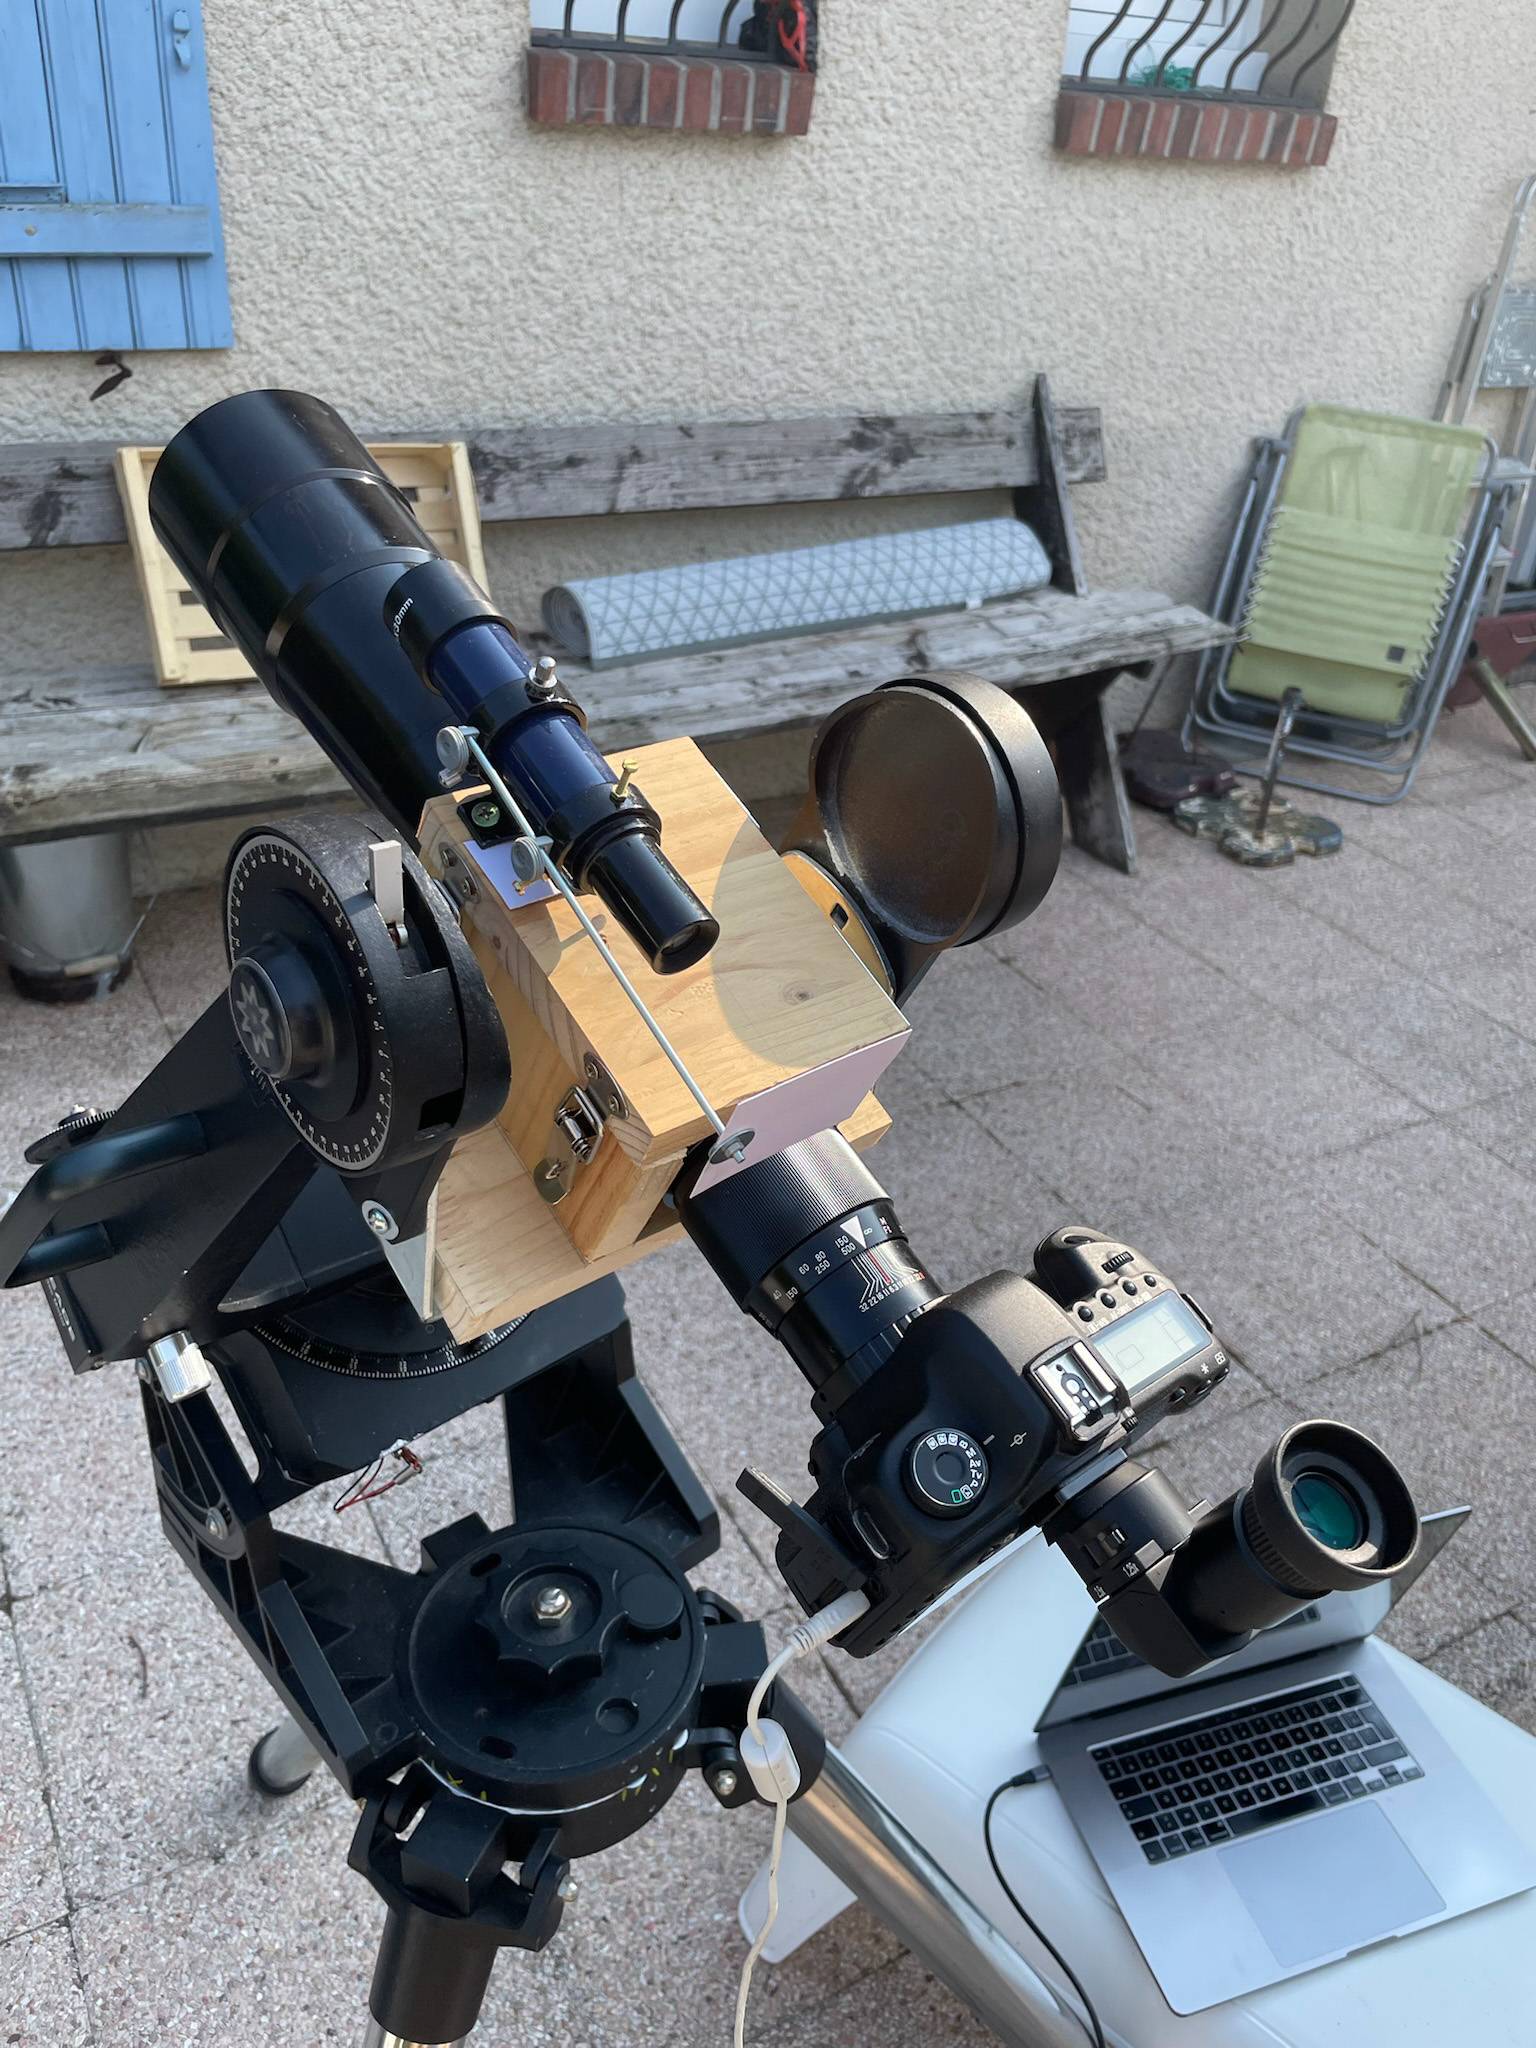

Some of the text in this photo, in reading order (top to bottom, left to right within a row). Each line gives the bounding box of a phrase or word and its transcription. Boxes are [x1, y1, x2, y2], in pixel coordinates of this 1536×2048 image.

[798, 1263, 810, 1275] 60
[814, 1250, 827, 1262] 80
[834, 1235, 849, 1248] 150
[785, 1286, 799, 1301] 150
[814, 1259, 831, 1275] 250
[840, 1242, 857, 1256] 500
[858, 1302, 870, 1313] 32
[867, 1296, 879, 1307] 22
[966, 1447, 976, 1458] M
[970, 1479, 979, 1488] P
